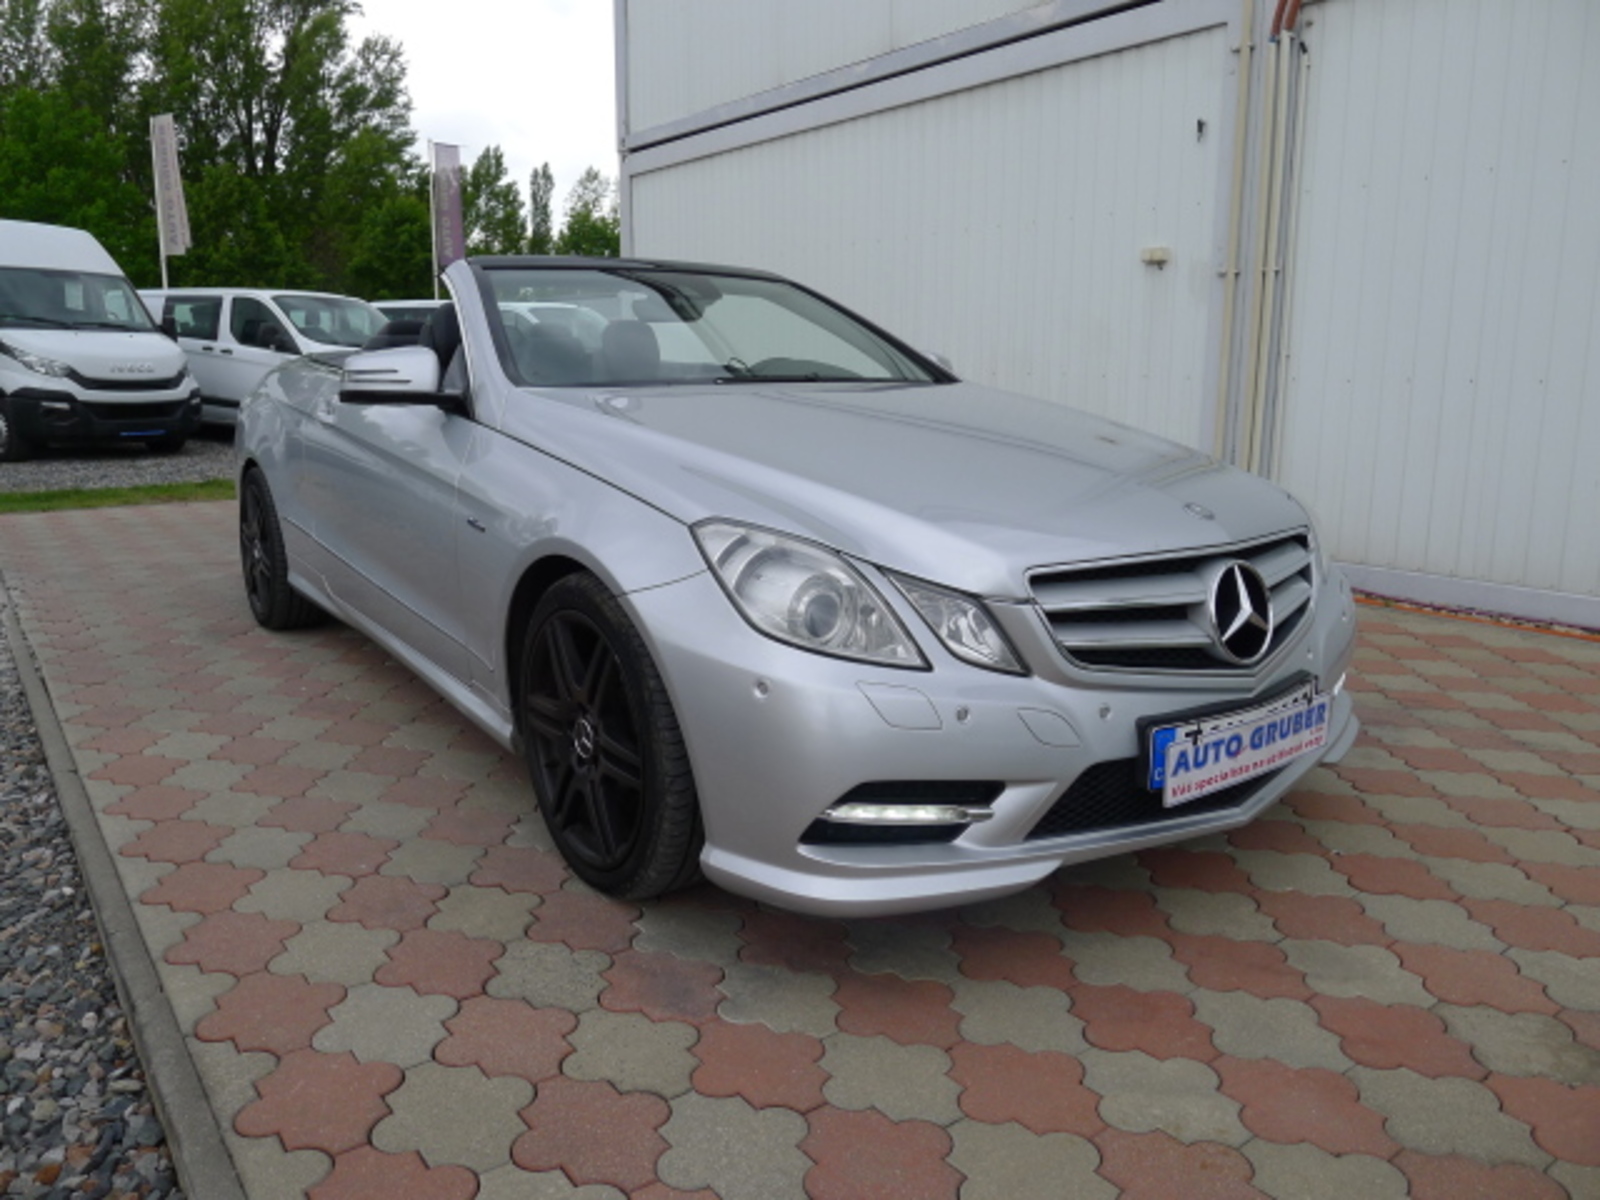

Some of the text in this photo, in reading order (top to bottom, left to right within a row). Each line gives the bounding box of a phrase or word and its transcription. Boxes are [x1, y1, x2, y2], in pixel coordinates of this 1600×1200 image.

[167, 199, 179, 246] AUTO
[441, 216, 453, 258] AUTO
[110, 362, 155, 373] IVECO
[1171, 734, 1243, 777] AUTO
[1250, 703, 1327, 750] GRUBER
